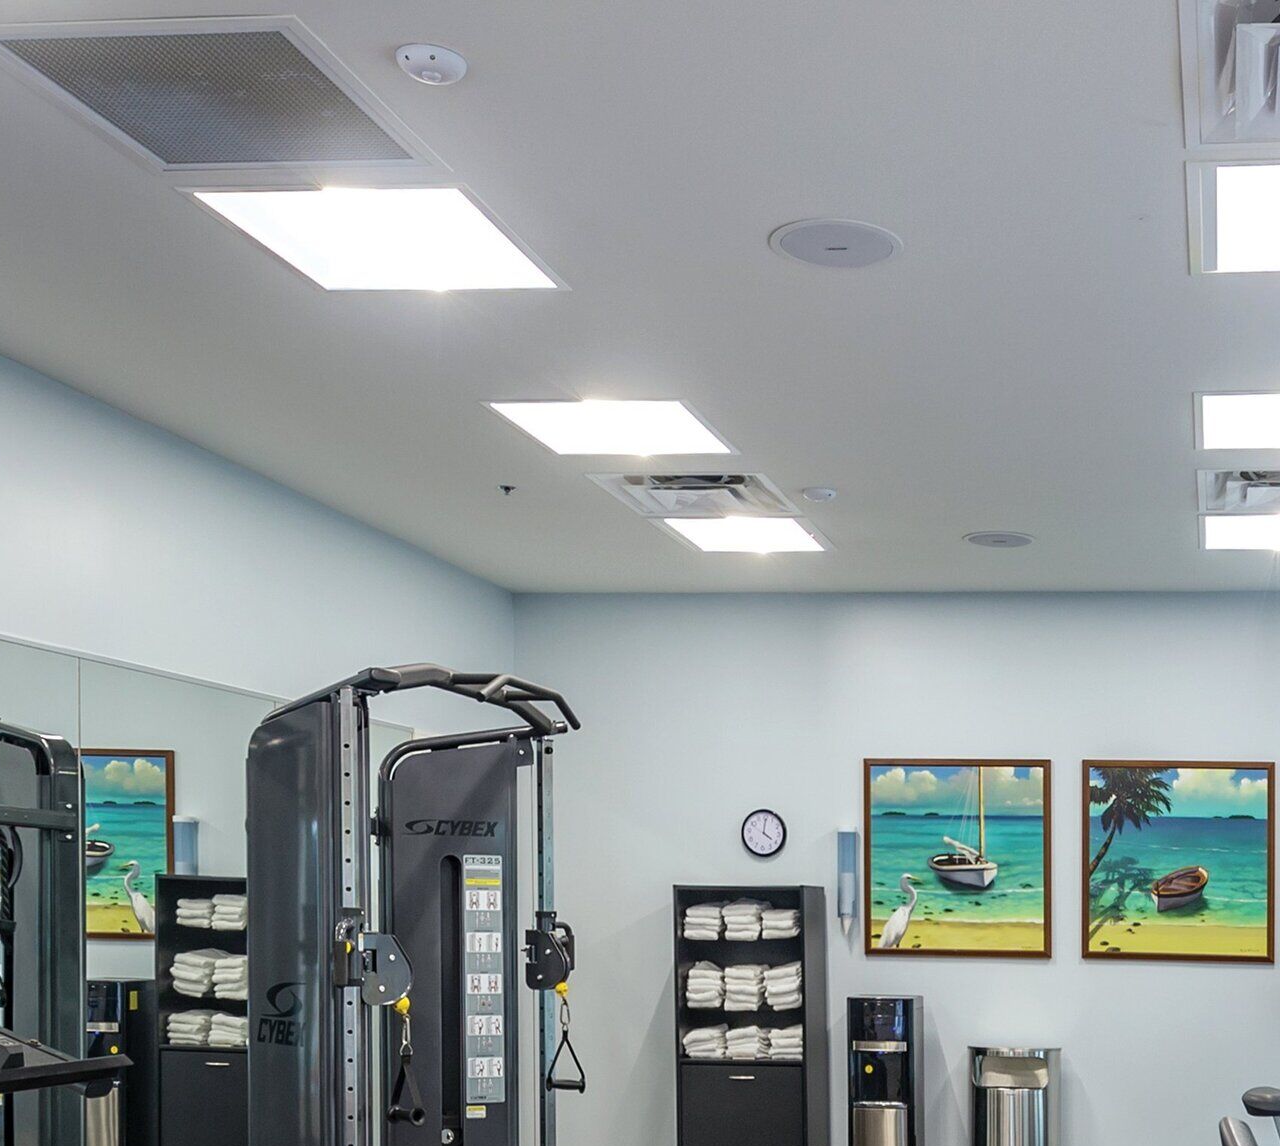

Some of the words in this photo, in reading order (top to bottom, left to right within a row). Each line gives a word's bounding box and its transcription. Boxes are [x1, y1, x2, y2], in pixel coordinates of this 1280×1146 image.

[434, 819, 499, 838] CYBEX
[464, 856, 501, 865] FT-325
[257, 1017, 306, 1048] CYBEX
